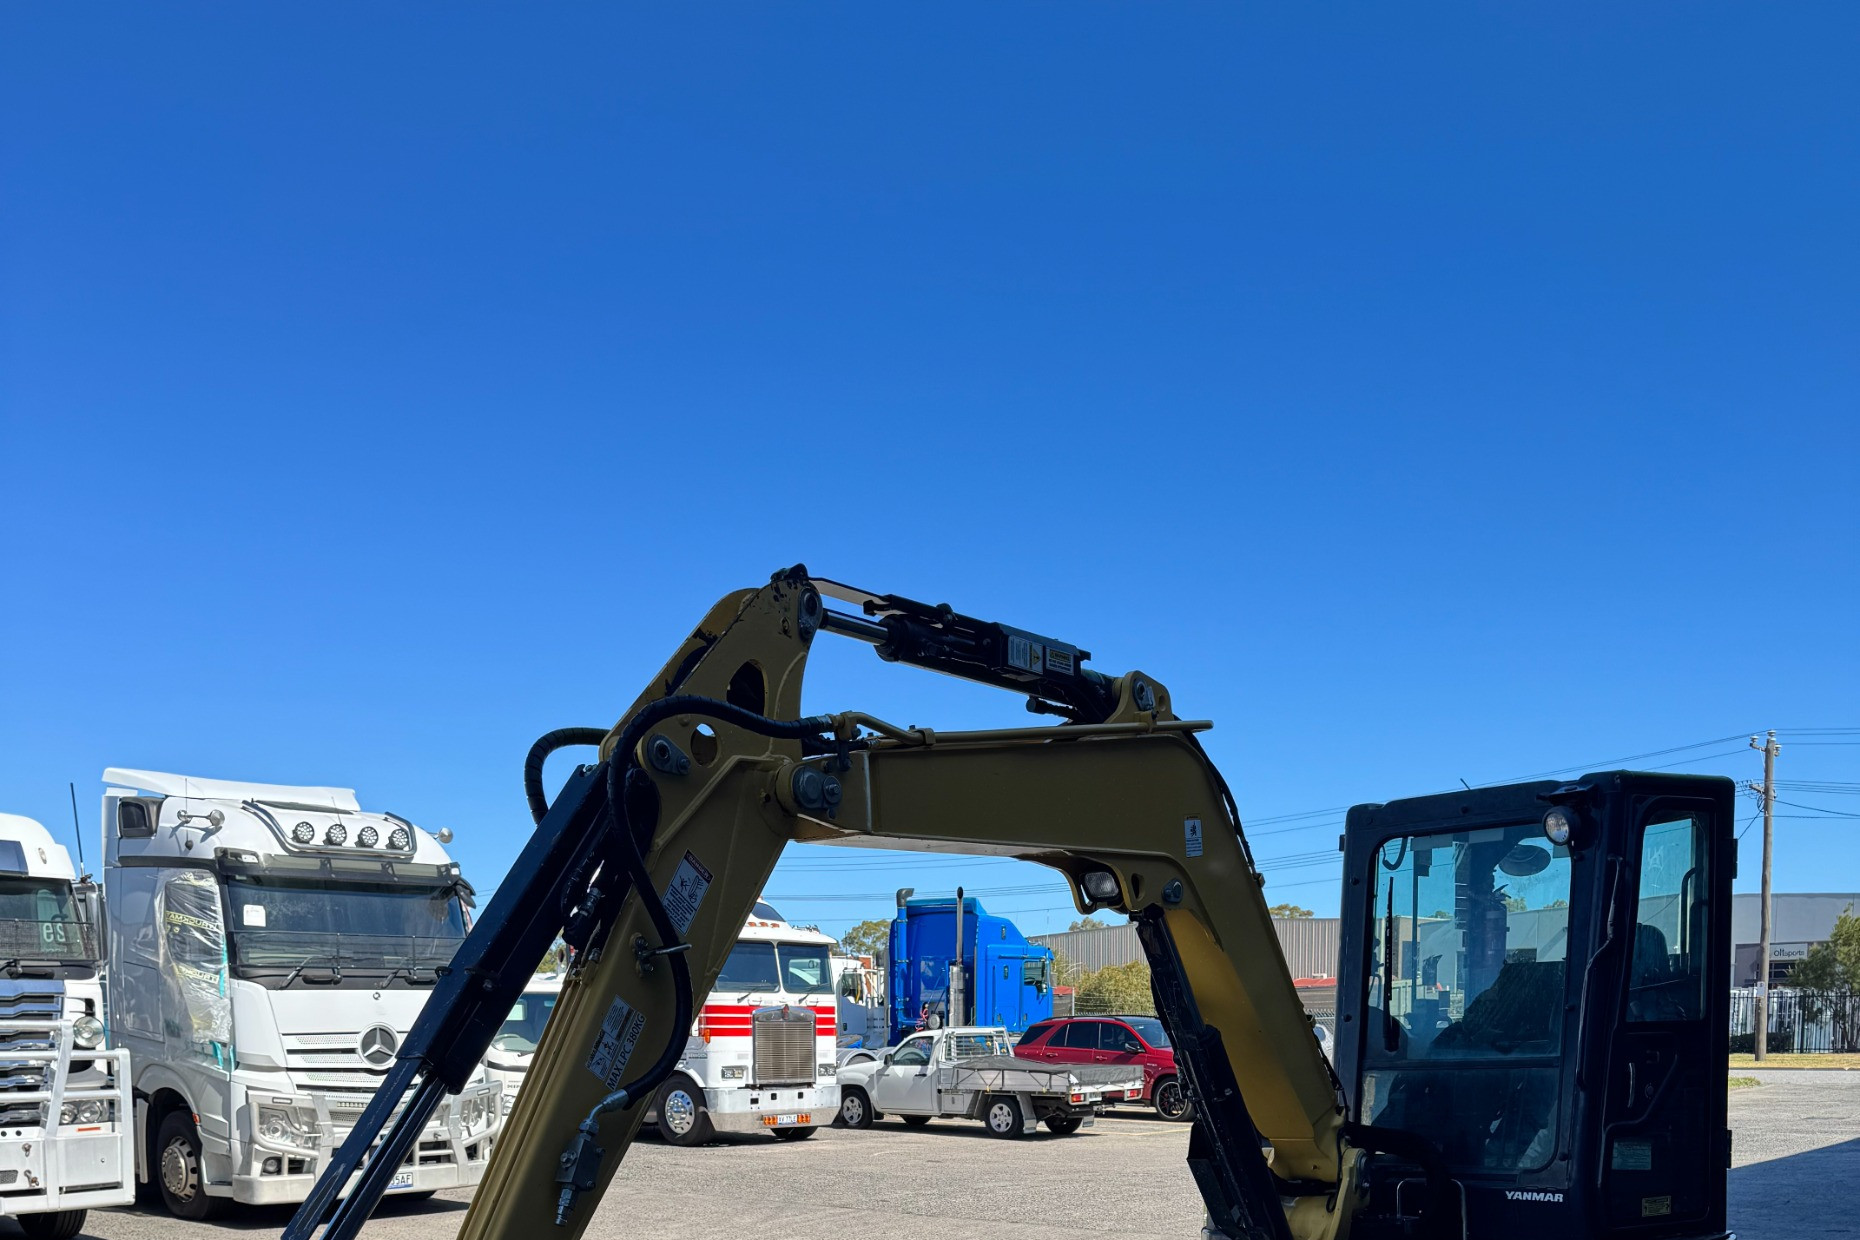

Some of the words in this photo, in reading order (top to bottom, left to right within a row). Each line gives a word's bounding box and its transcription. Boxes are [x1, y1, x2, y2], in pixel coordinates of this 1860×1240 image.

[606, 1065, 623, 1090] MAX
[618, 1045, 631, 1065] LPC
[626, 1013, 646, 1047] 380KG
[1505, 1190, 1564, 1203] YANMAR
